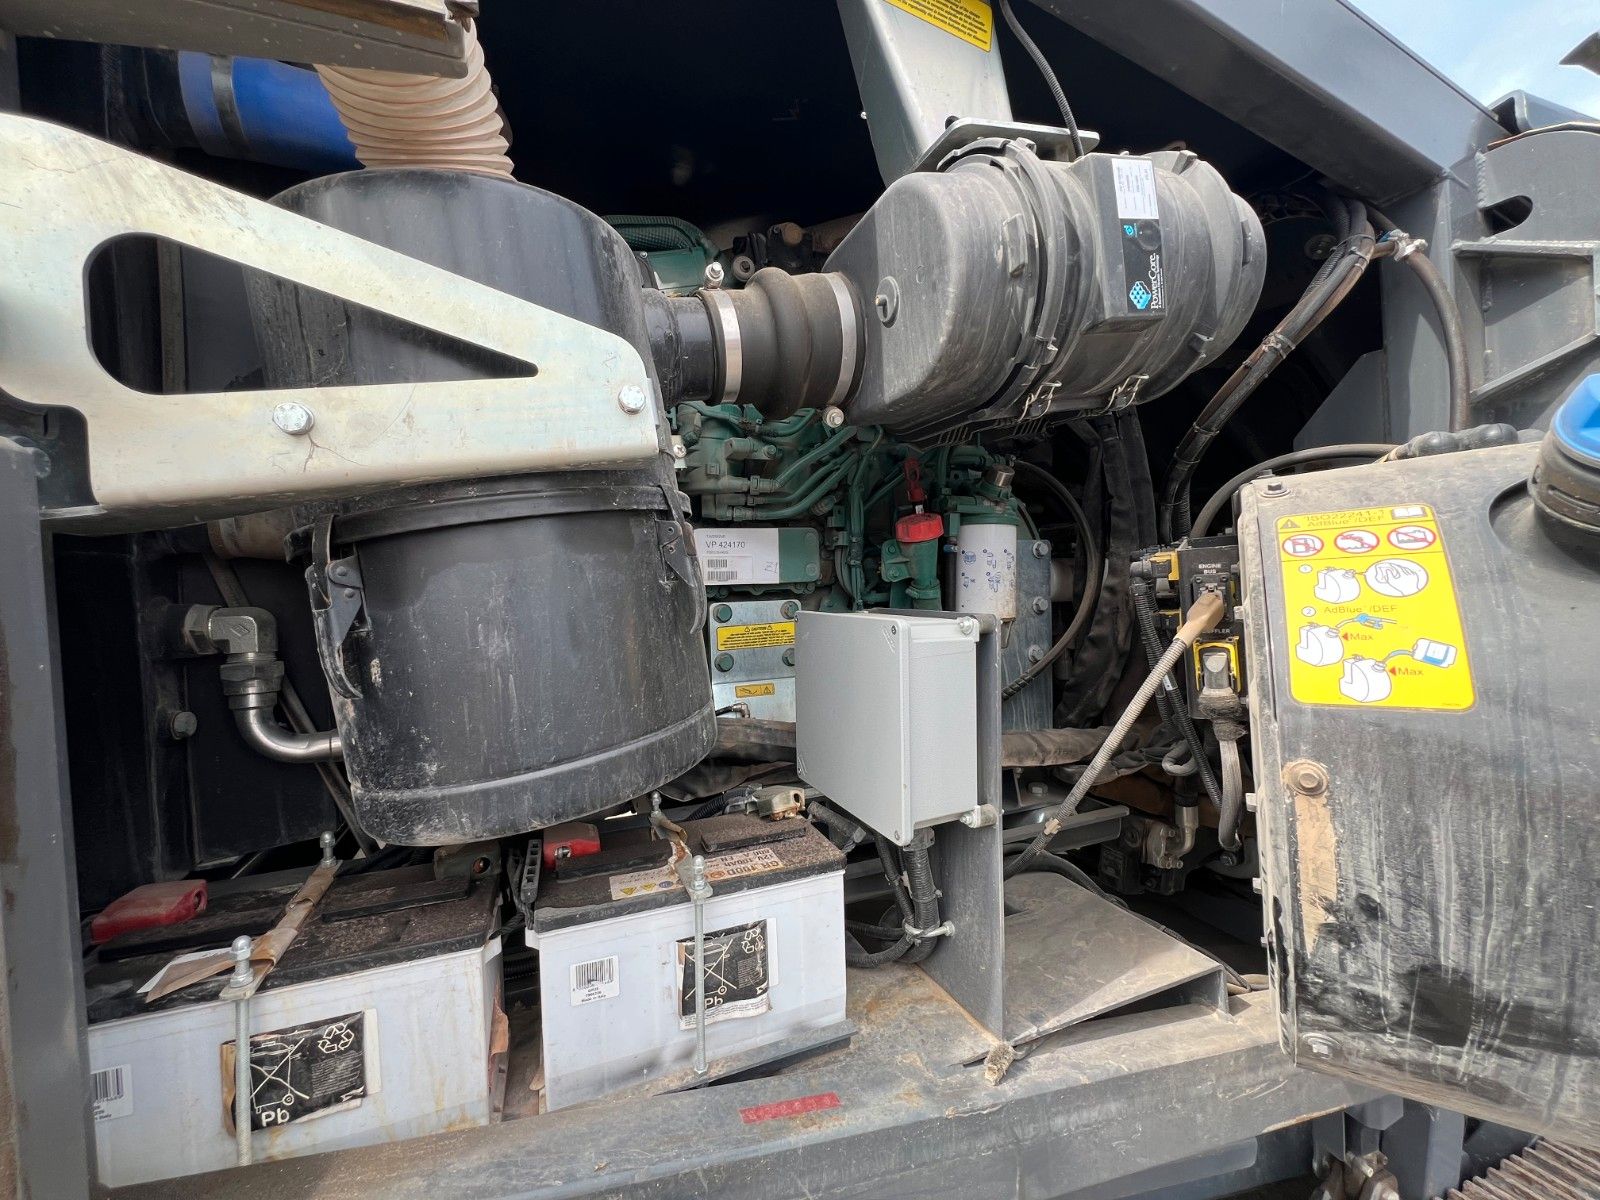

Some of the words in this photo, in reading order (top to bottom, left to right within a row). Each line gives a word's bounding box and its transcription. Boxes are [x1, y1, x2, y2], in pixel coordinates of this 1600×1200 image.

[719, 541, 746, 549] 424170
[1350, 633, 1373, 641] Max
[1398, 667, 1424, 676] Max
[704, 996, 724, 1009] Pb
[261, 1107, 290, 1127] Pb
